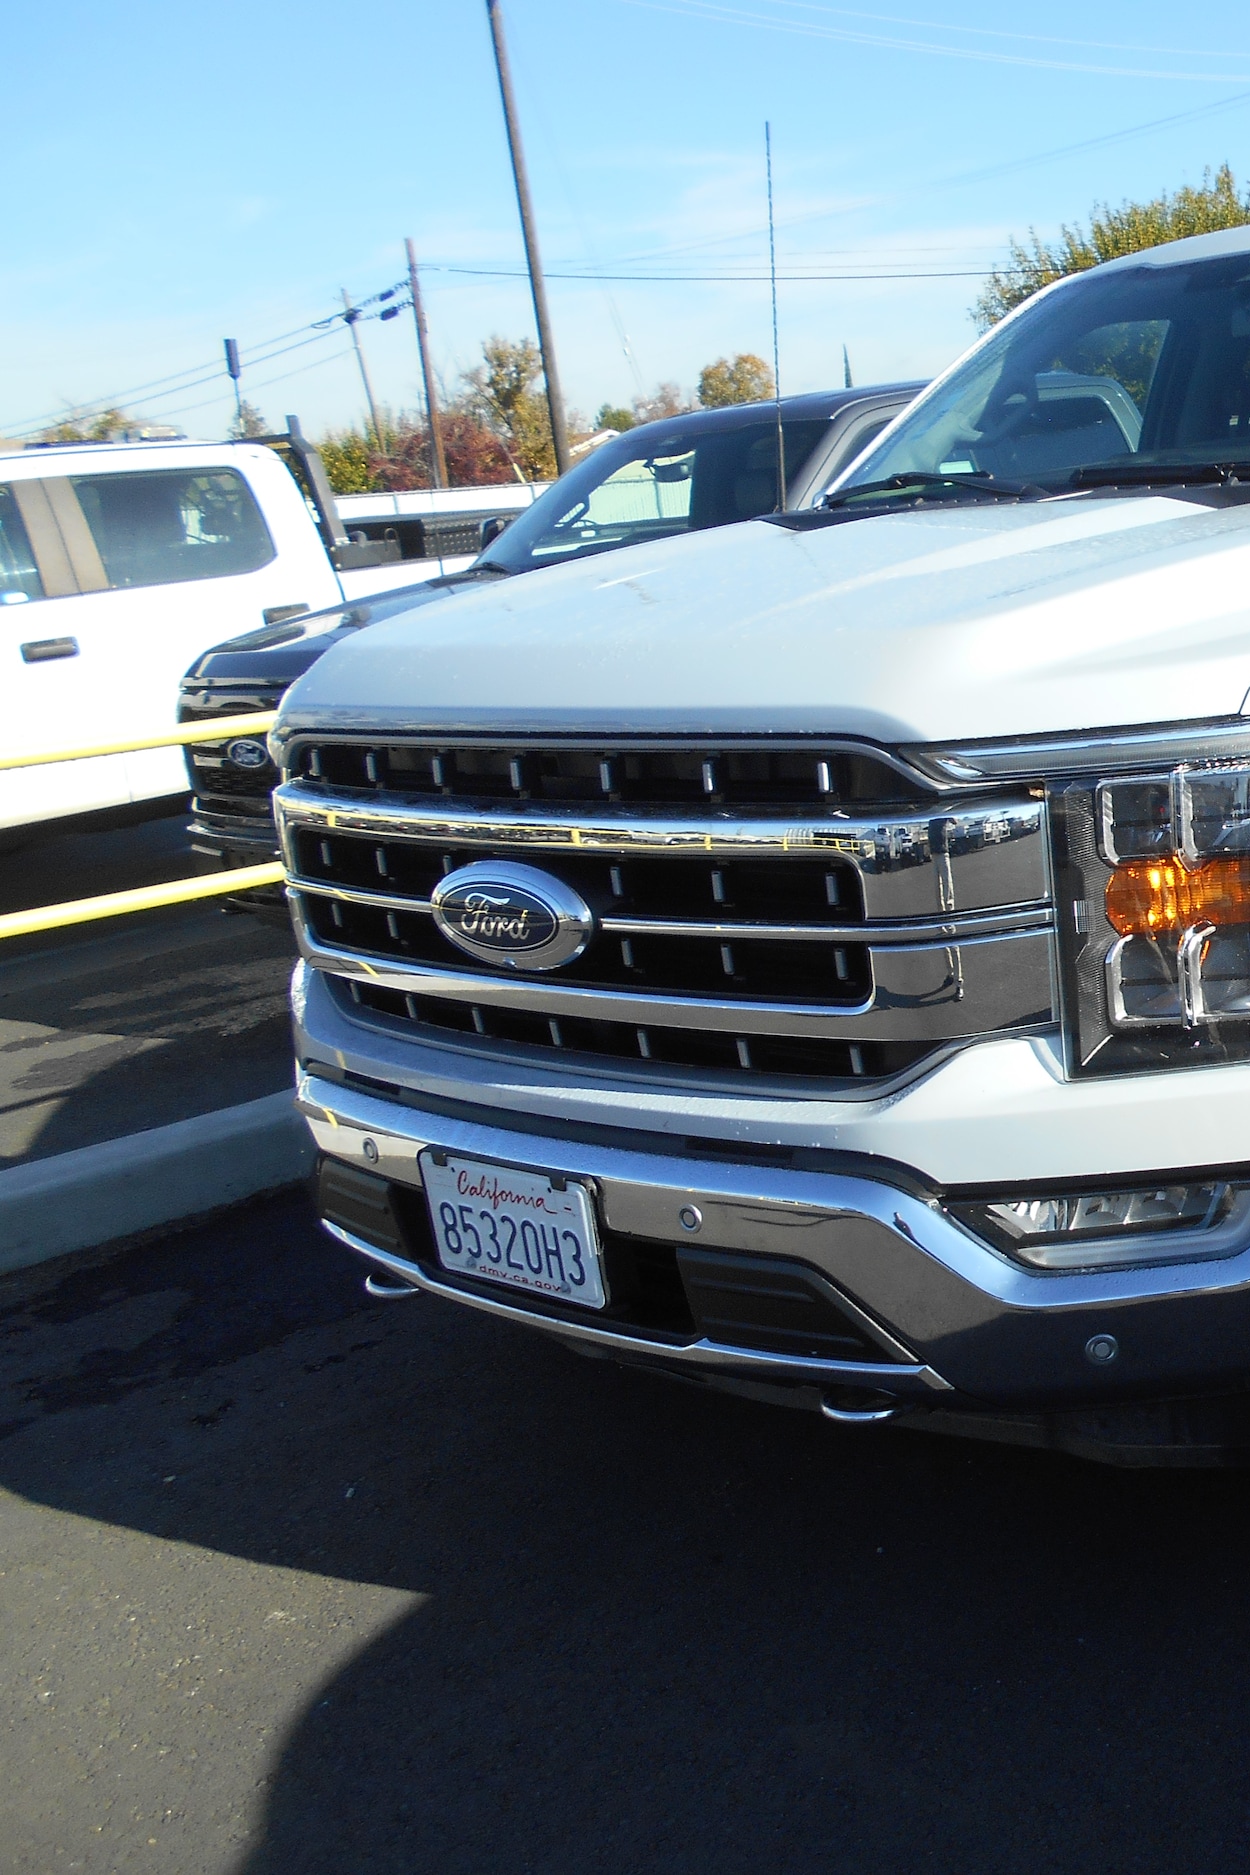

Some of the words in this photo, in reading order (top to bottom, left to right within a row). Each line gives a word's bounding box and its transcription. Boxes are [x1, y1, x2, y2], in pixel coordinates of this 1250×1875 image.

[460, 892, 530, 941] Ford
[456, 1169, 558, 1215] California
[439, 1201, 586, 1286] 85320H3
[479, 1264, 562, 1292] dmv.ca.gov
